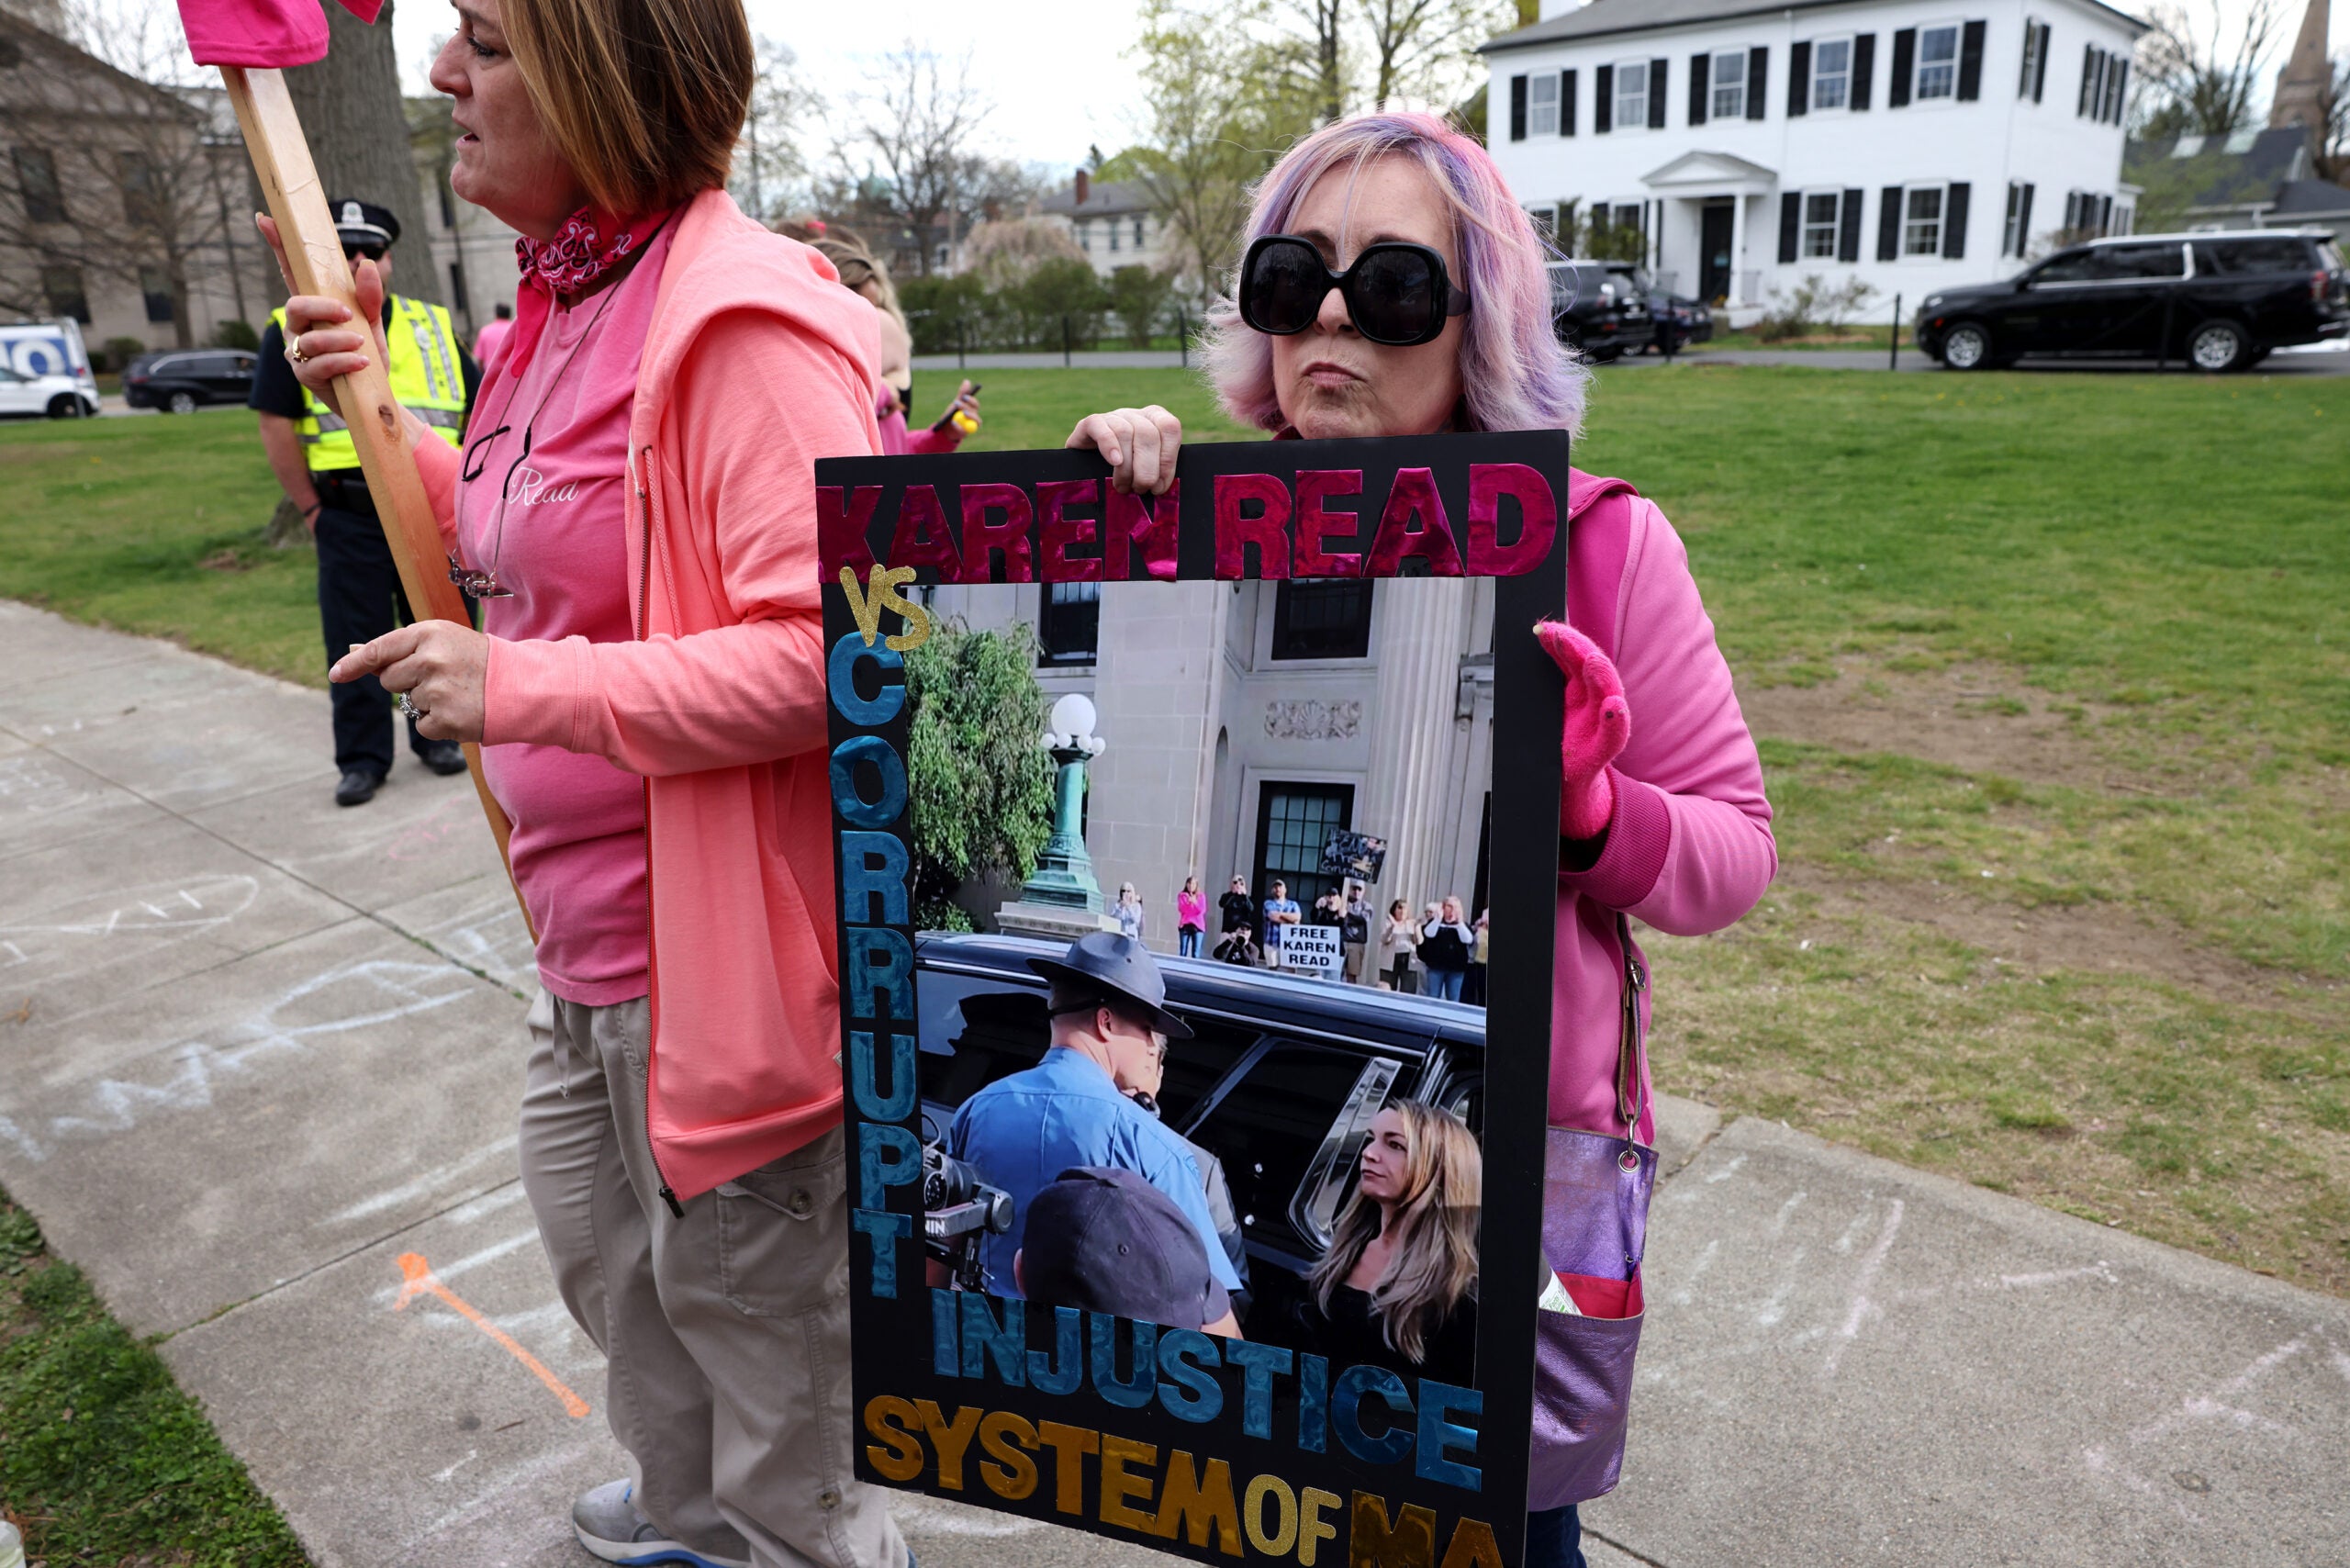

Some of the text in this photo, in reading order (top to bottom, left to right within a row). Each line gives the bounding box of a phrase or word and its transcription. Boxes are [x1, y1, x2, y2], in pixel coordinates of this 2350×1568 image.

[509, 466, 578, 506] Read
[816, 464, 1558, 584] KAREN READ
[839, 564, 930, 651] VS
[828, 632, 923, 1299] CORRUPT
[1283, 941, 1336, 954] KAREN
[1289, 954, 1330, 967] READ
[1290, 927, 1329, 940] FREE
[931, 1289, 1484, 1493] INJUSTICE
[863, 1394, 1504, 1568] SYSTEM OF MA
